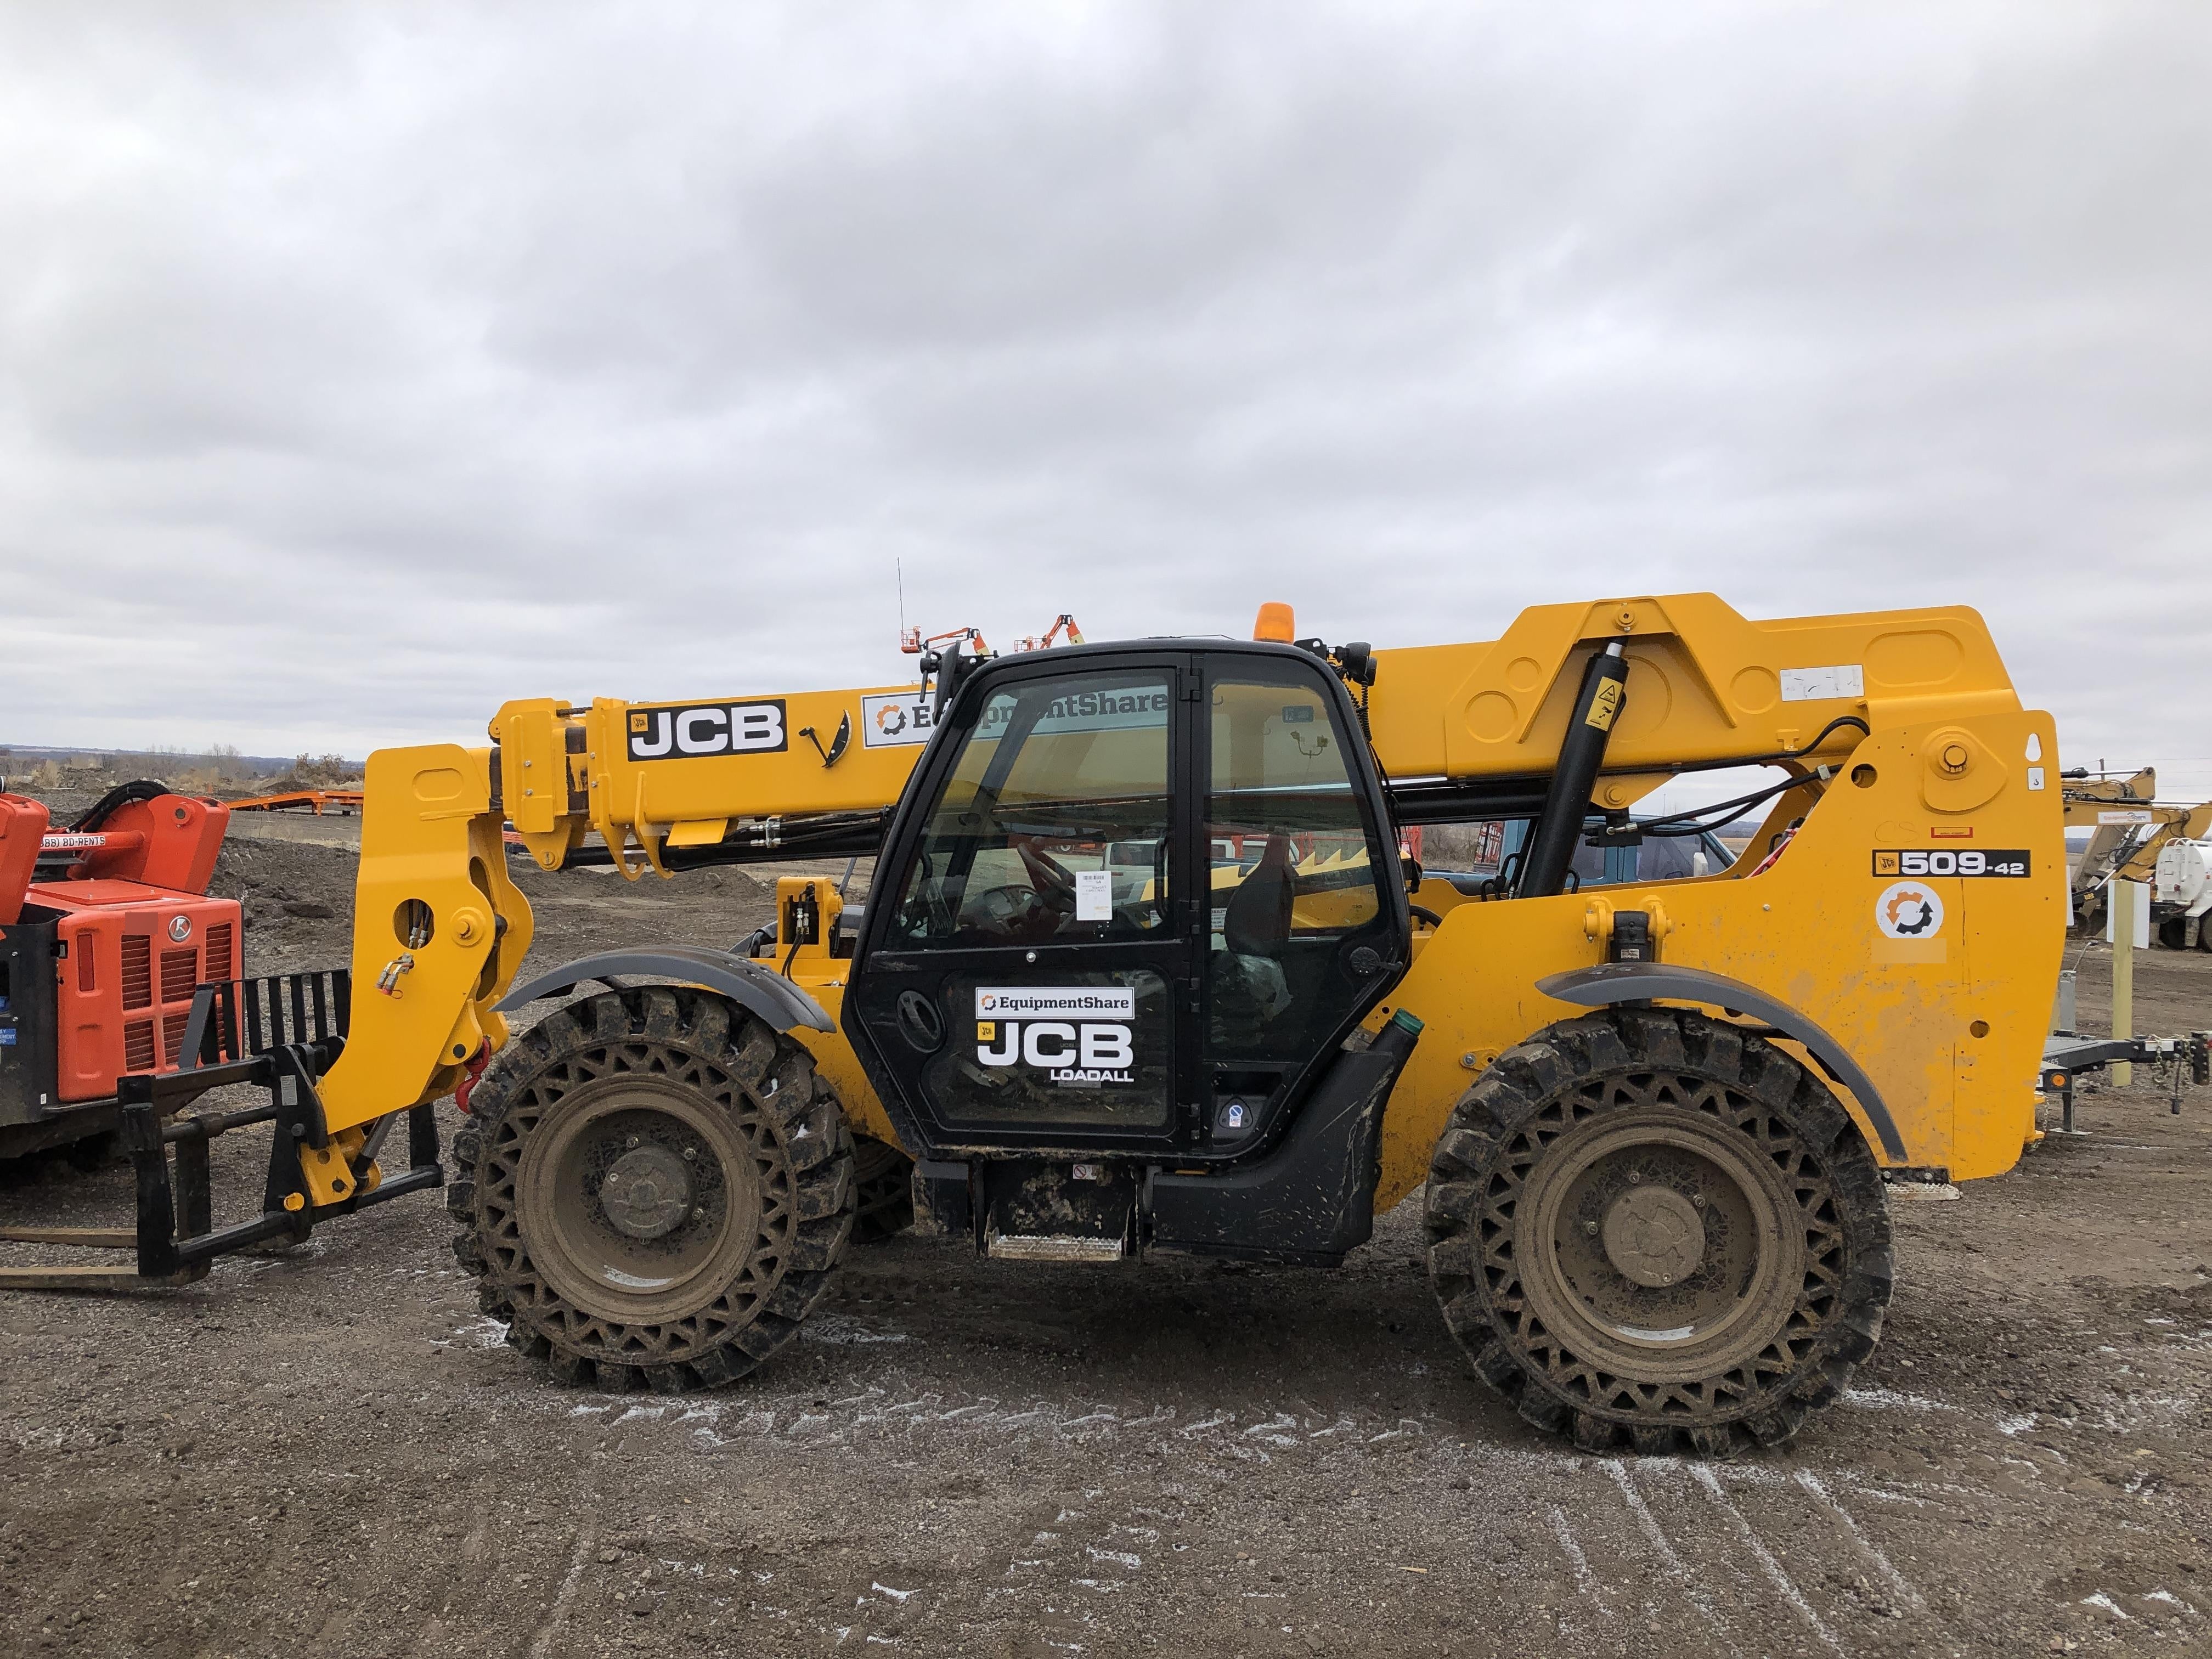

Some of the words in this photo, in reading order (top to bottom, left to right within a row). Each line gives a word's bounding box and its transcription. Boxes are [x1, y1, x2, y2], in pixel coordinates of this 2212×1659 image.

[632, 705, 783, 756] JCB
[1881, 858, 1895, 868] JCB
[1901, 852, 2024, 874] 509-42
[1000, 996, 1129, 1011] EquipmentShare
[977, 1022, 1134, 1068] JCB
[1051, 1069, 1135, 1082] LOADALL
